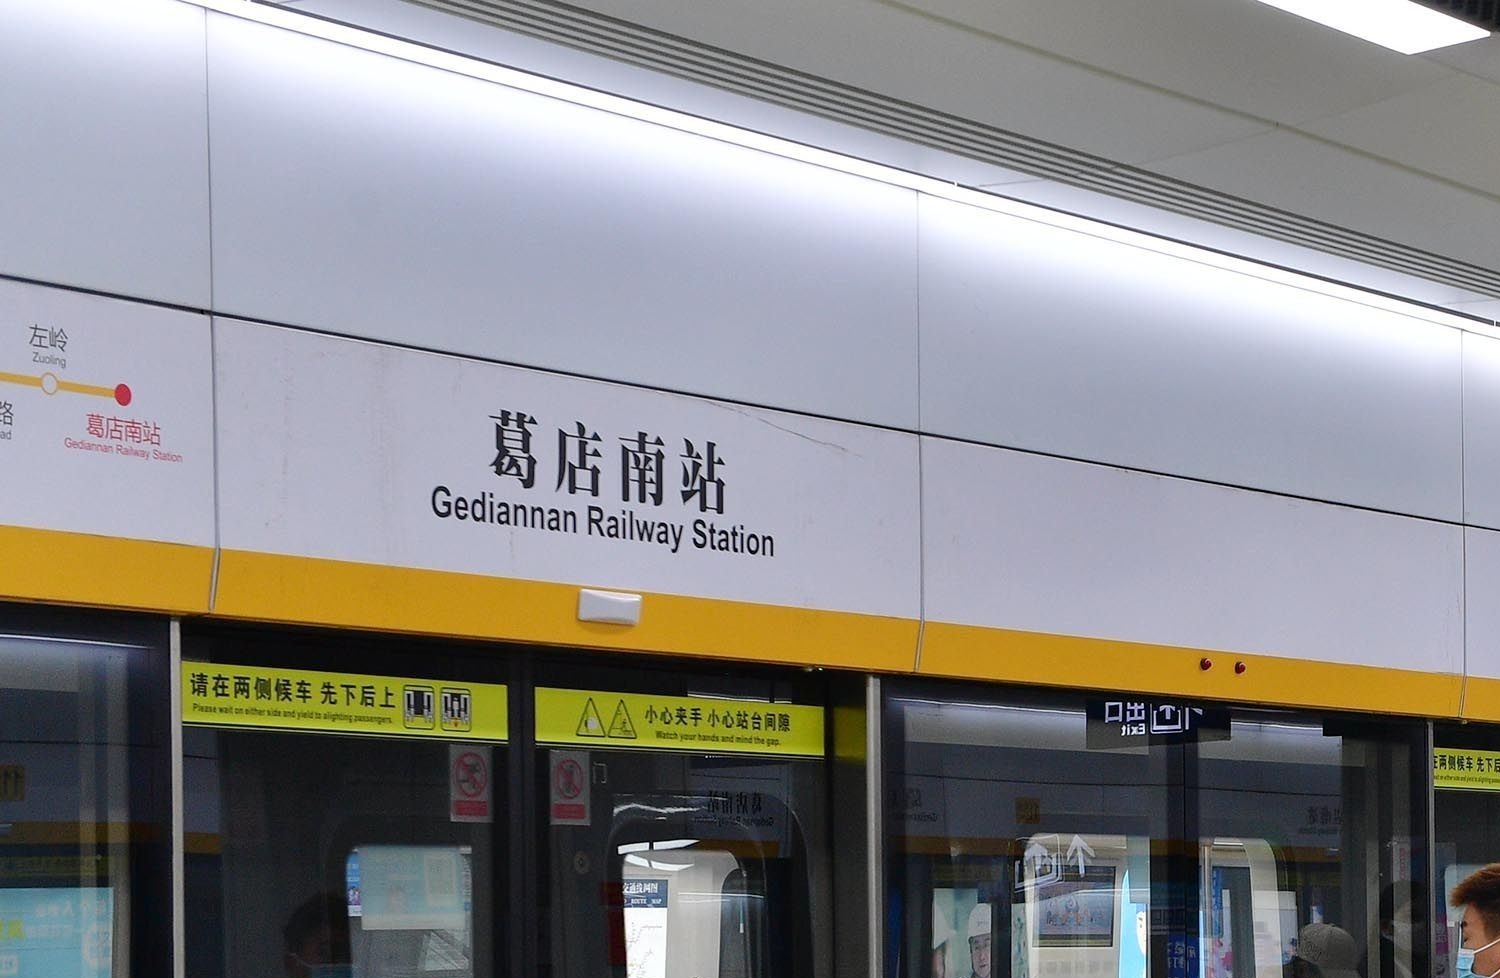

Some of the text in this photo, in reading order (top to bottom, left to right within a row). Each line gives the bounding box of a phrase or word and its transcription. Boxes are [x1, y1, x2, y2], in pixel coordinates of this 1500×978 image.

[28, 324, 69, 352] 左岭
[32, 352, 66, 368] Zuoling
[86, 413, 161, 446] 葛店南站
[64, 437, 183, 463] Gediannan Railway Station
[489, 408, 727, 515] 葛店南站
[431, 484, 775, 557] Gediannan Railway Station
[190, 673, 396, 709] 请在两侧候车 先下后上
[645, 705, 790, 732] 小心夹手 小心站台间隙
[656, 731, 678, 739] Watch
[698, 734, 719, 742] hands
[736, 736, 753, 744] mind
